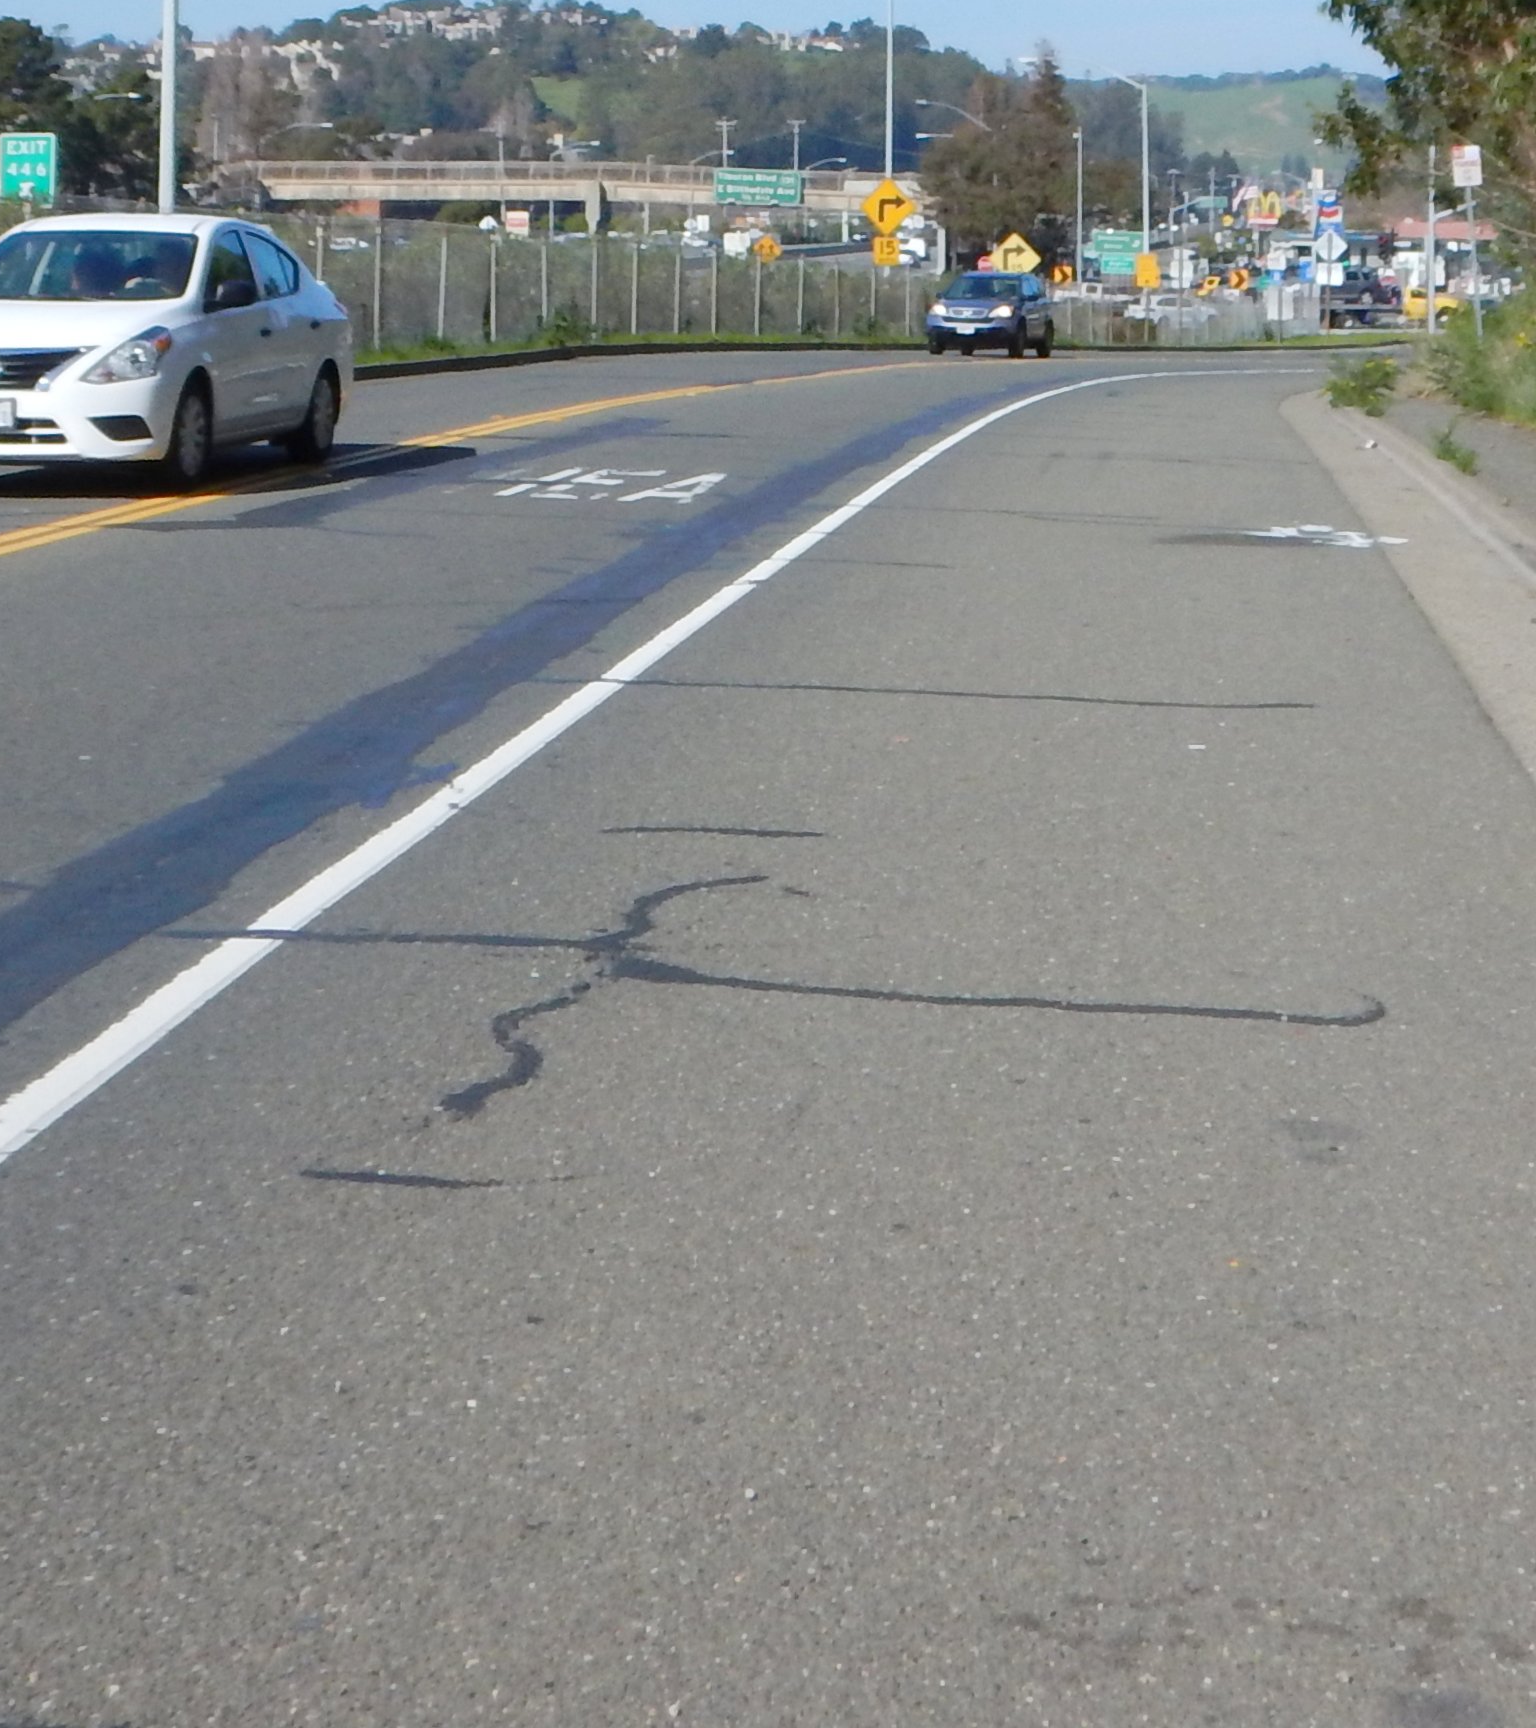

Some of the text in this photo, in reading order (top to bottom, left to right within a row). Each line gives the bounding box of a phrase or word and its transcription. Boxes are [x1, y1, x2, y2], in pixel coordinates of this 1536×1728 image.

[6, 140, 47, 155] EXIT
[6, 162, 47, 177] 446
[879, 240, 896, 255] 15
